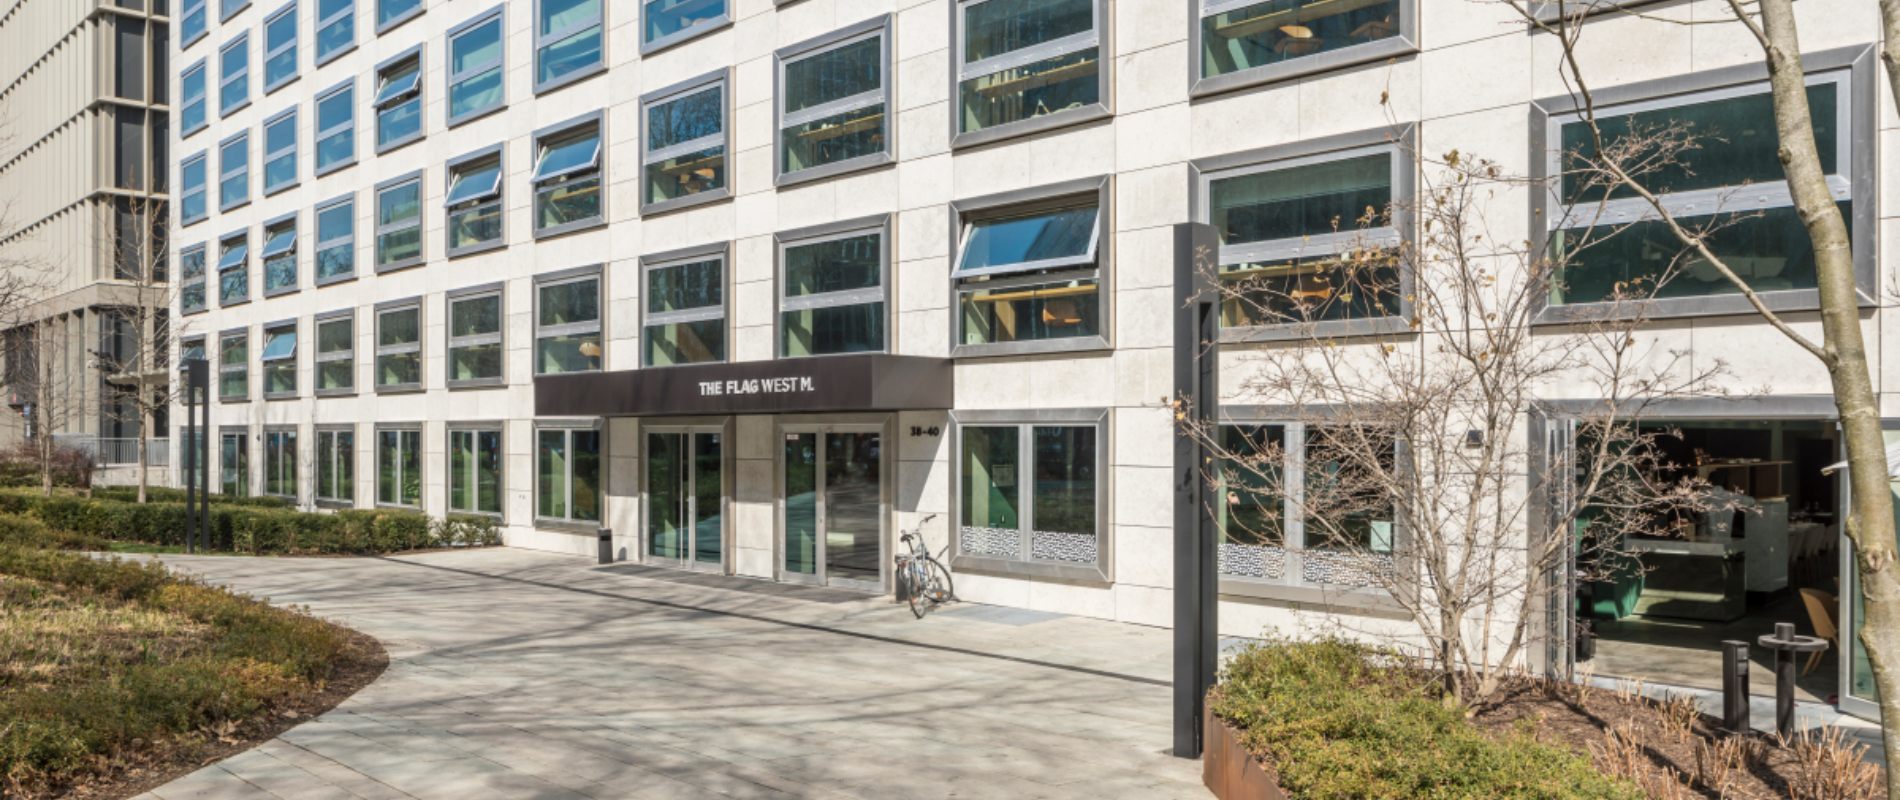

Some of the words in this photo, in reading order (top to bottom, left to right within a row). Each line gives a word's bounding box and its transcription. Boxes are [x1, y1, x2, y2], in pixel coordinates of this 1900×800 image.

[699, 381, 723, 396] THE
[726, 379, 759, 394] FLAG
[761, 377, 799, 393] WEST
[800, 376, 815, 391] M.
